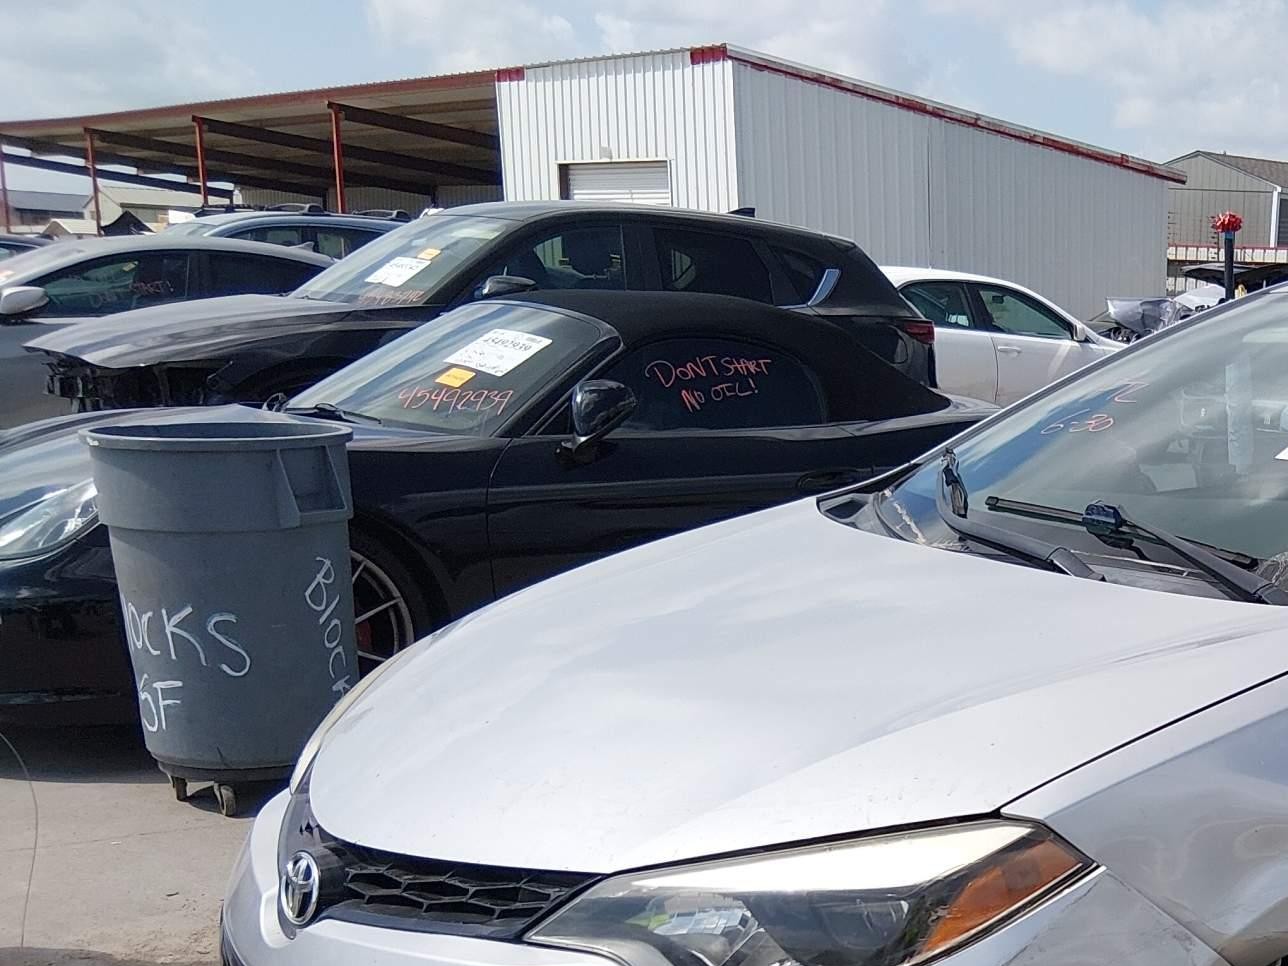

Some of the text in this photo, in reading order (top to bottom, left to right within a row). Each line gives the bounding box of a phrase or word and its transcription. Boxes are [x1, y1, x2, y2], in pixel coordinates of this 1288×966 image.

[720, 357, 772, 376] START
[398, 385, 514, 416] 45492939
[681, 388, 705, 412] NO
